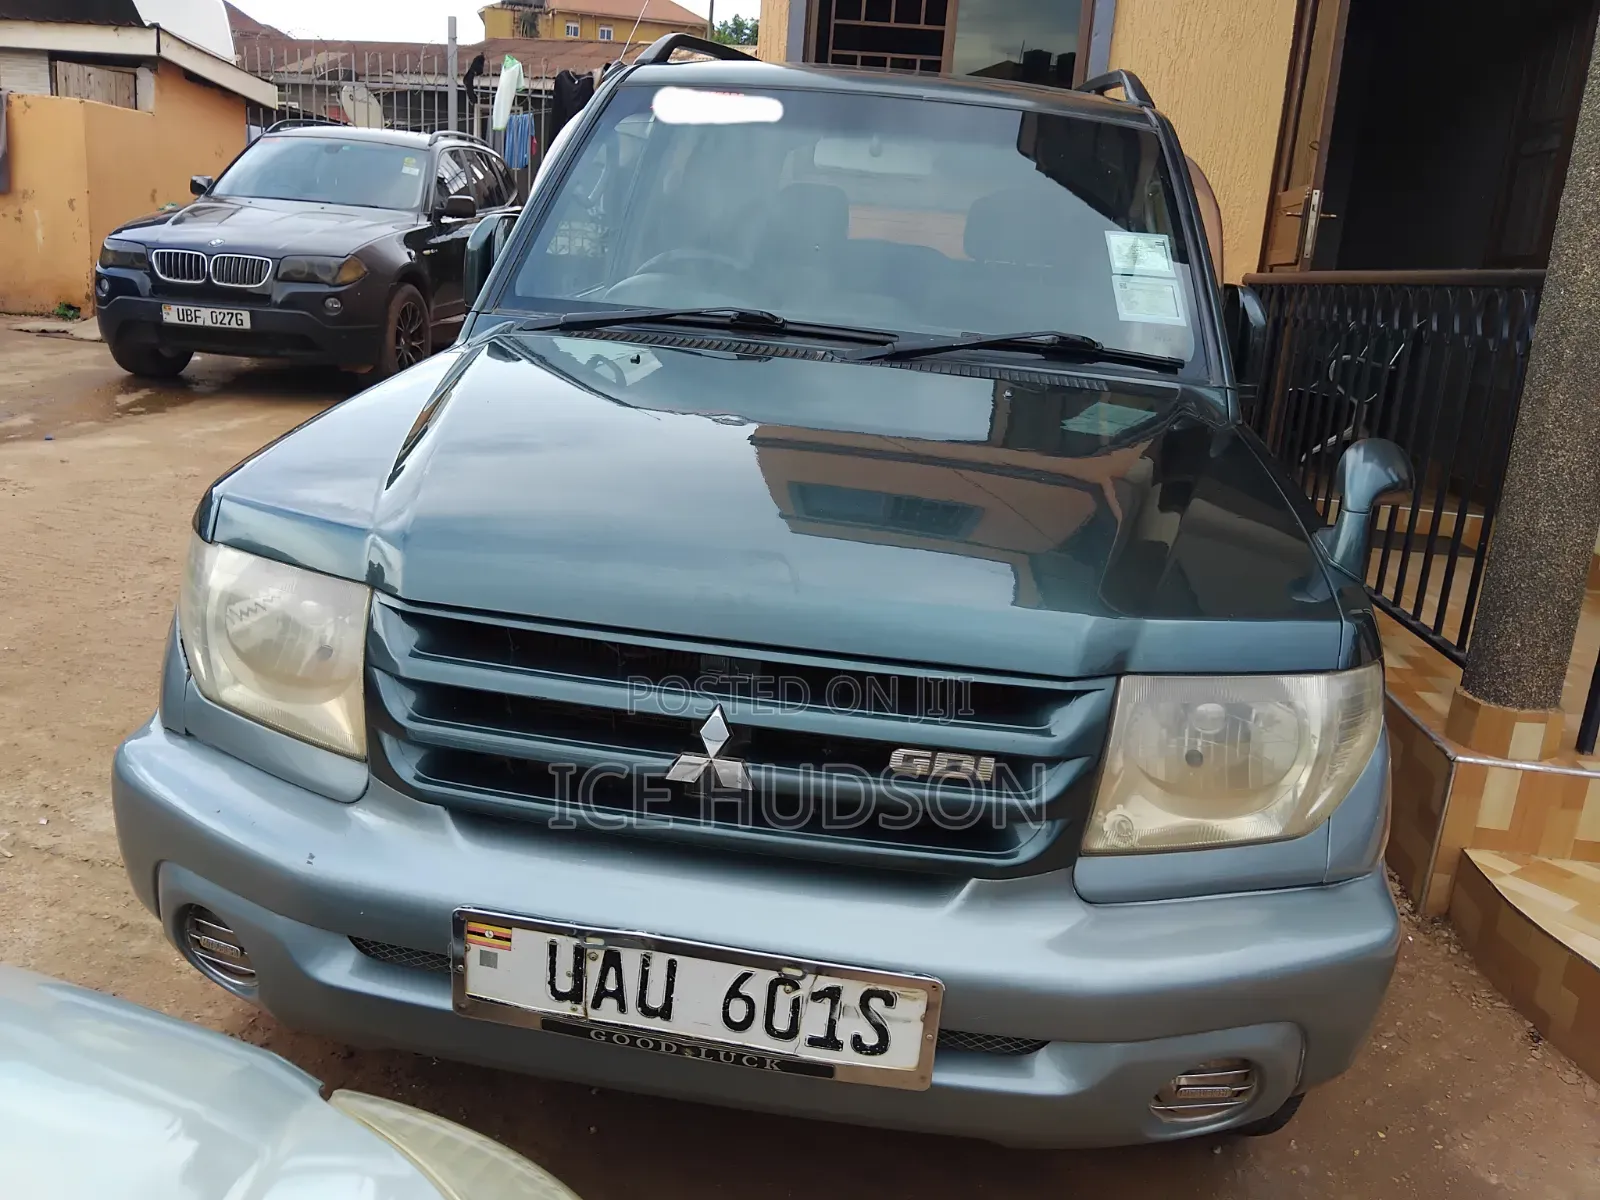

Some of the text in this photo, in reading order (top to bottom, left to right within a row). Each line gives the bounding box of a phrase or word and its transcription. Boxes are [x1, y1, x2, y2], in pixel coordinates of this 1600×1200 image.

[177, 307, 244, 326] UBF 027G
[889, 748, 995, 781] GDI
[546, 937, 898, 1057] UAU 601S
[589, 1028, 782, 1072] GOOD LUCK
